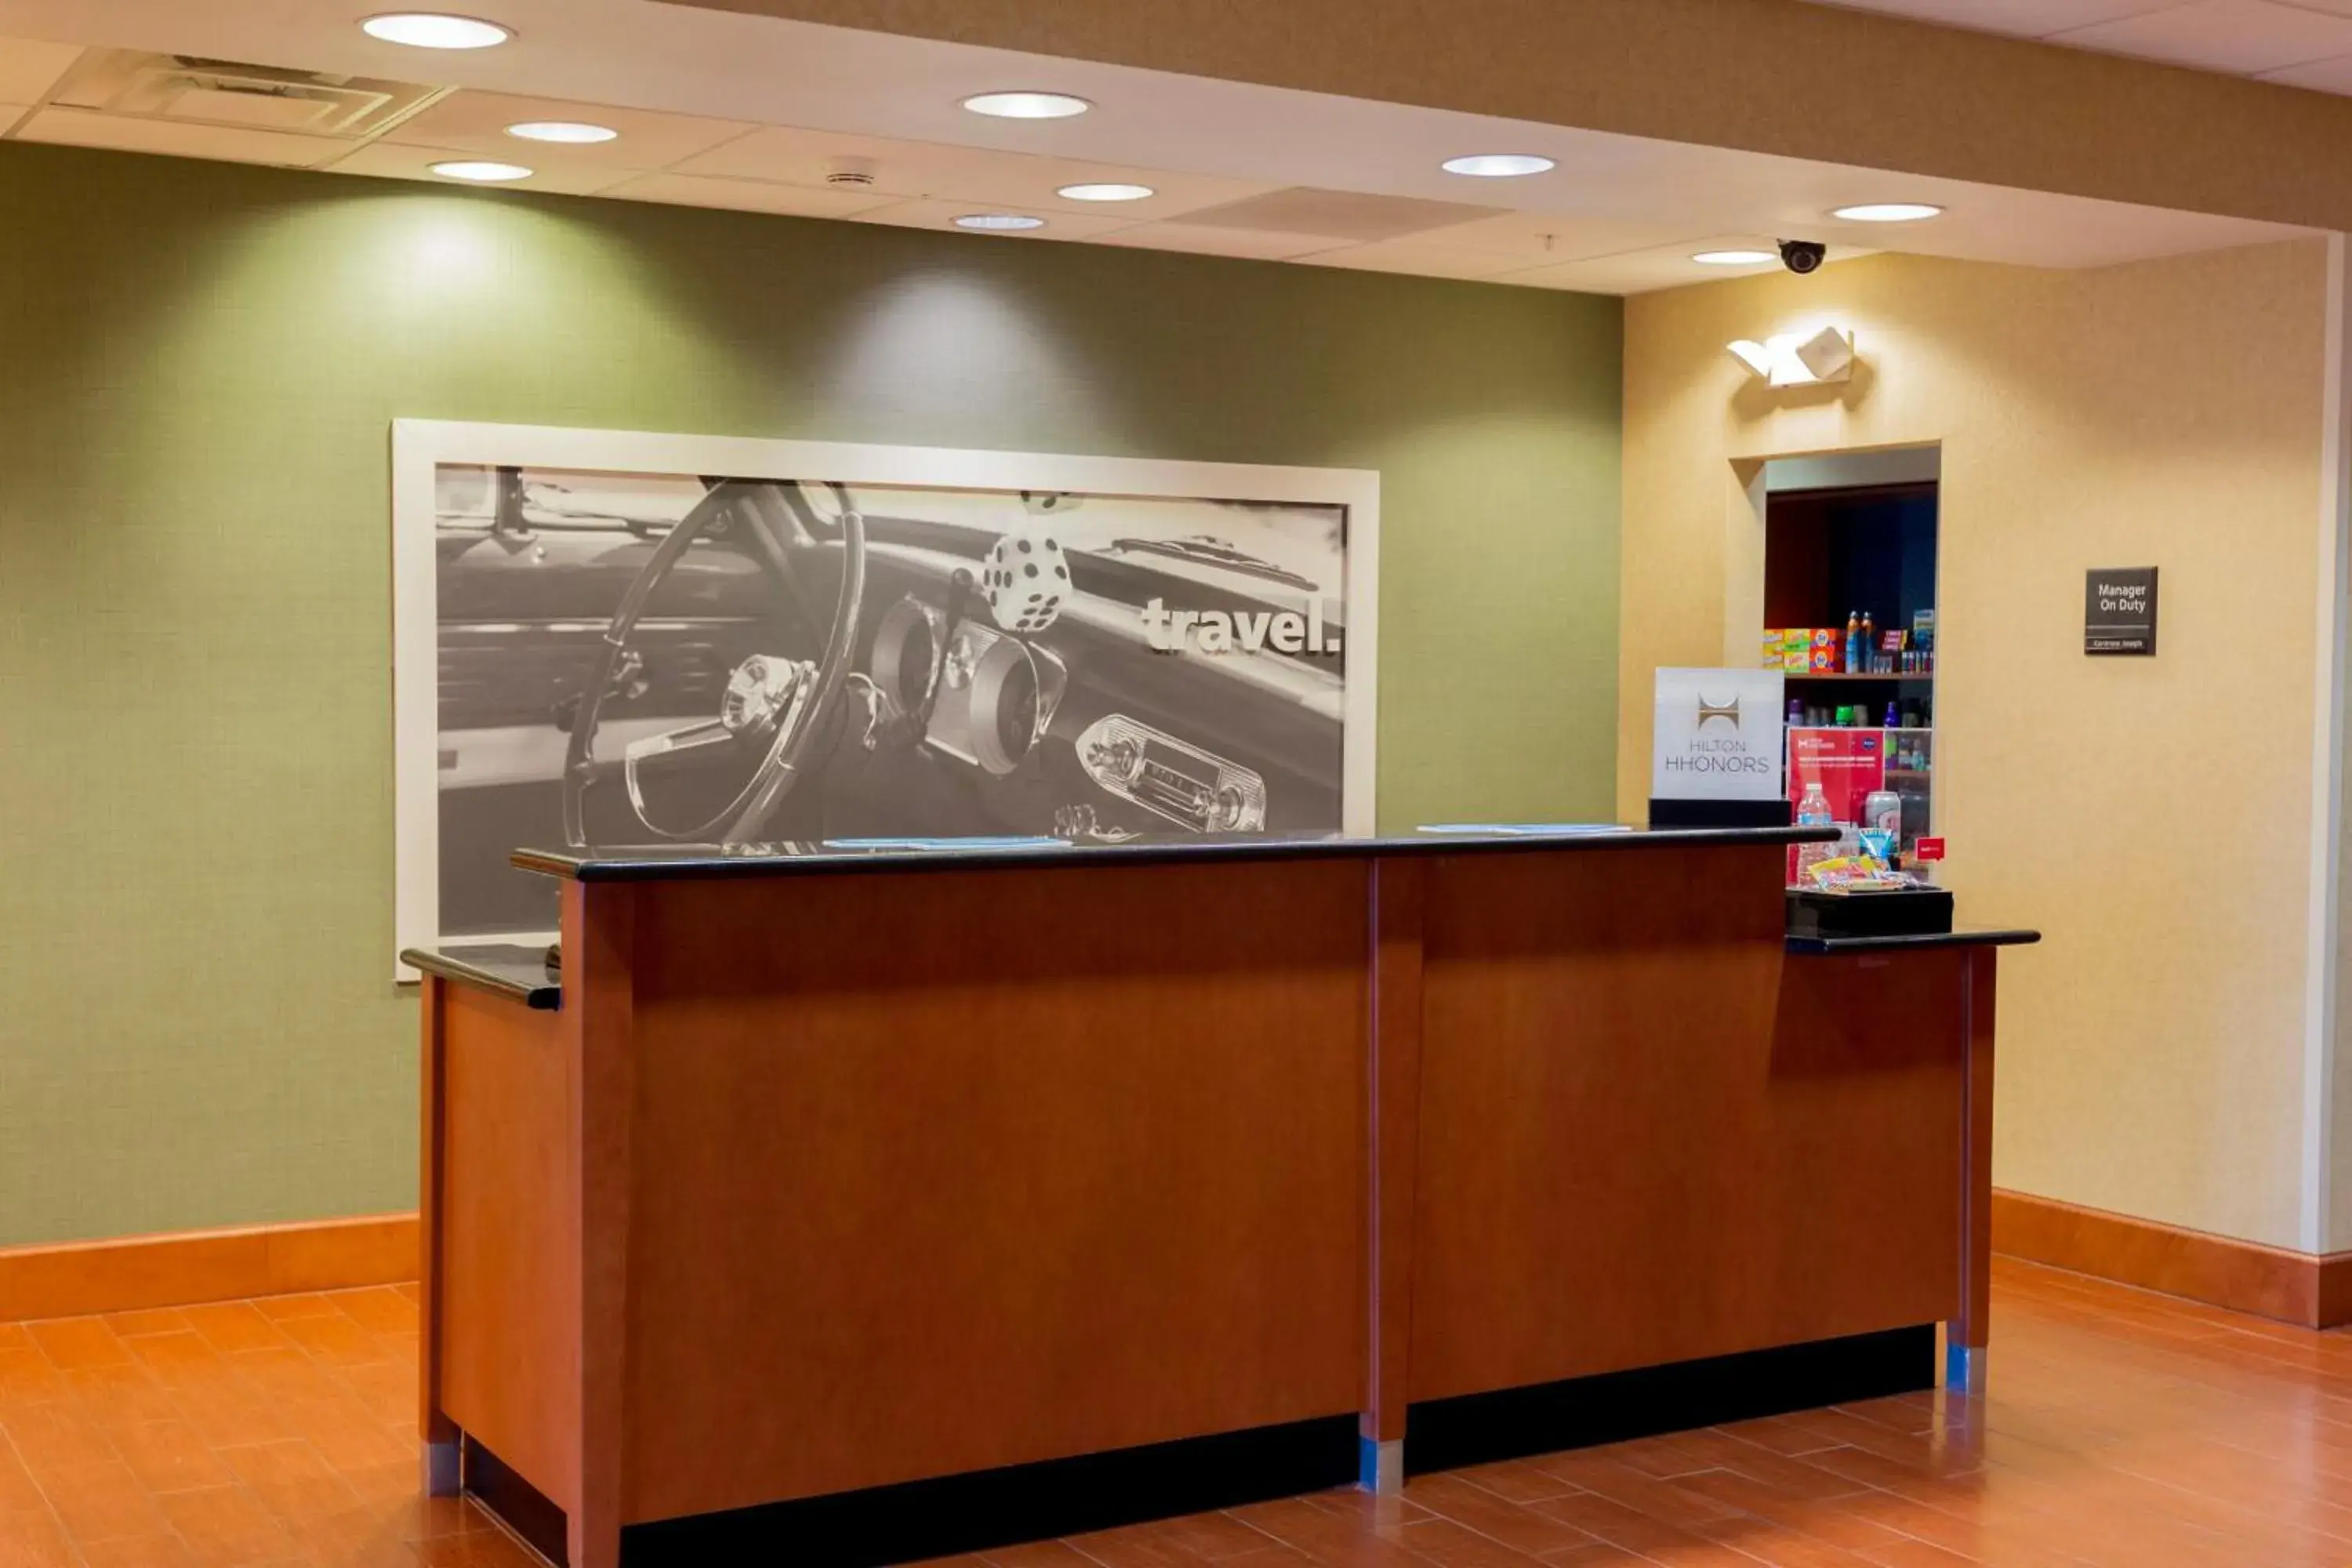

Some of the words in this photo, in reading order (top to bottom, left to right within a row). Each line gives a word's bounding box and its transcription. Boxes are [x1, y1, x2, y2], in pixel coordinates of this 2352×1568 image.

[2098, 583, 2147, 598] Manager
[2100, 598, 2116, 611] On
[2119, 598, 2146, 613] Duty
[1142, 595, 1341, 653] travel.
[1690, 739, 1747, 753] HILTON
[1665, 756, 1769, 773] HHONORS
